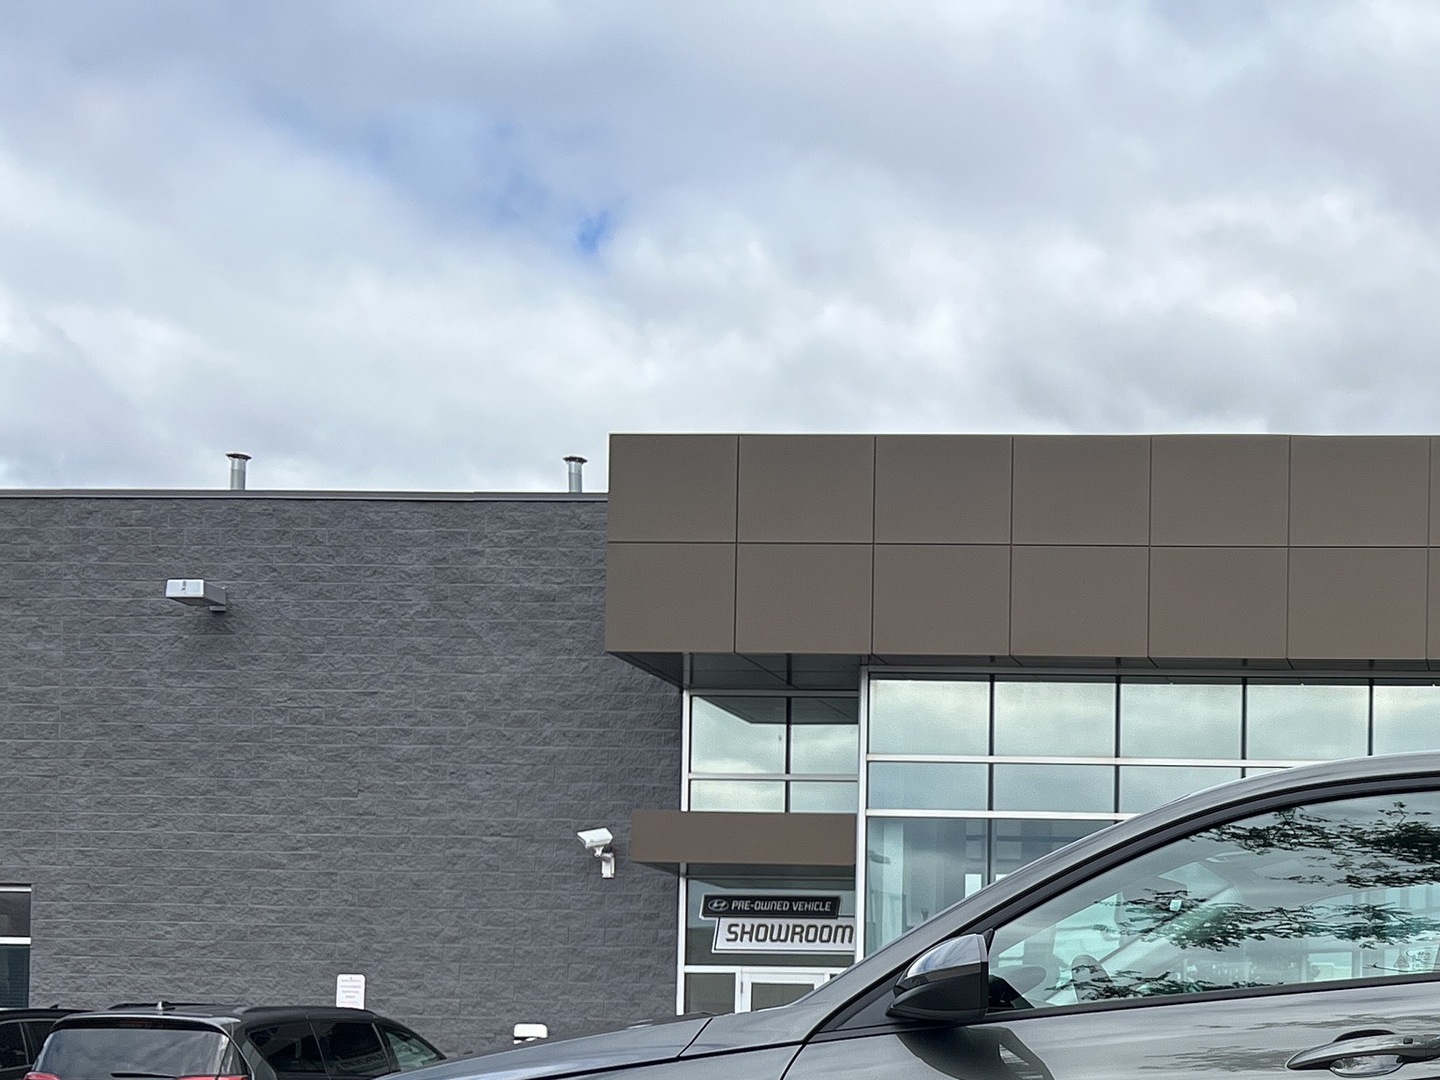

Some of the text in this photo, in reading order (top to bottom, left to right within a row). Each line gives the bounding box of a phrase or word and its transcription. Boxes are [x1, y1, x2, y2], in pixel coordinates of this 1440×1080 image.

[731, 899, 833, 913] PRE-OWNED VEHICLE
[726, 923, 855, 944] SHOWROOM
